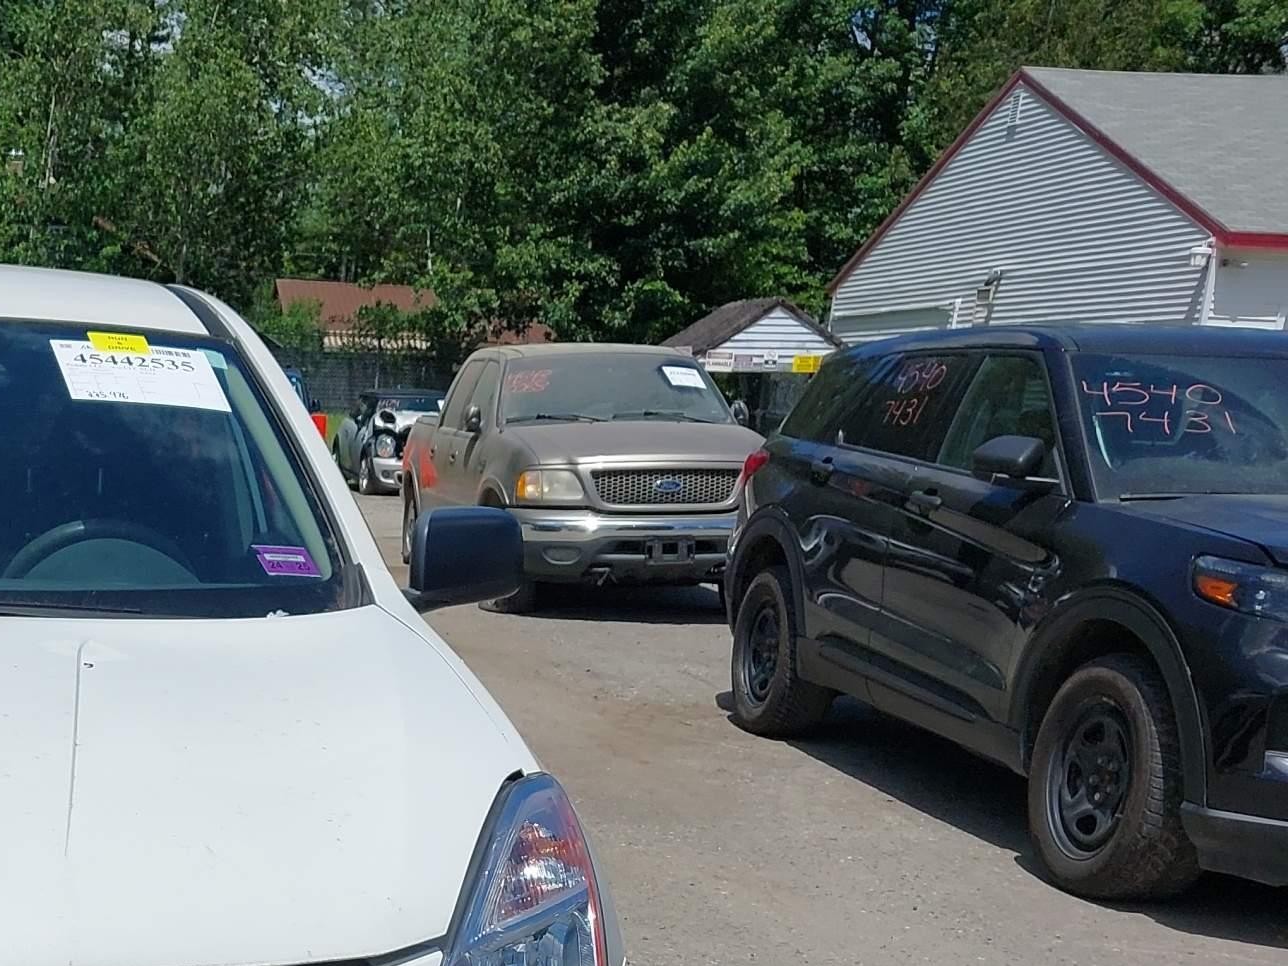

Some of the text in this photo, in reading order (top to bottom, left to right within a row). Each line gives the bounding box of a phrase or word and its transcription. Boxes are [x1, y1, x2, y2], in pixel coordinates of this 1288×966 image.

[73, 353, 195, 373] 45442535
[897, 360, 948, 394] 4540
[1081, 380, 1222, 406] 4540
[882, 395, 929, 425] 7431
[1095, 410, 1236, 435] 7431
